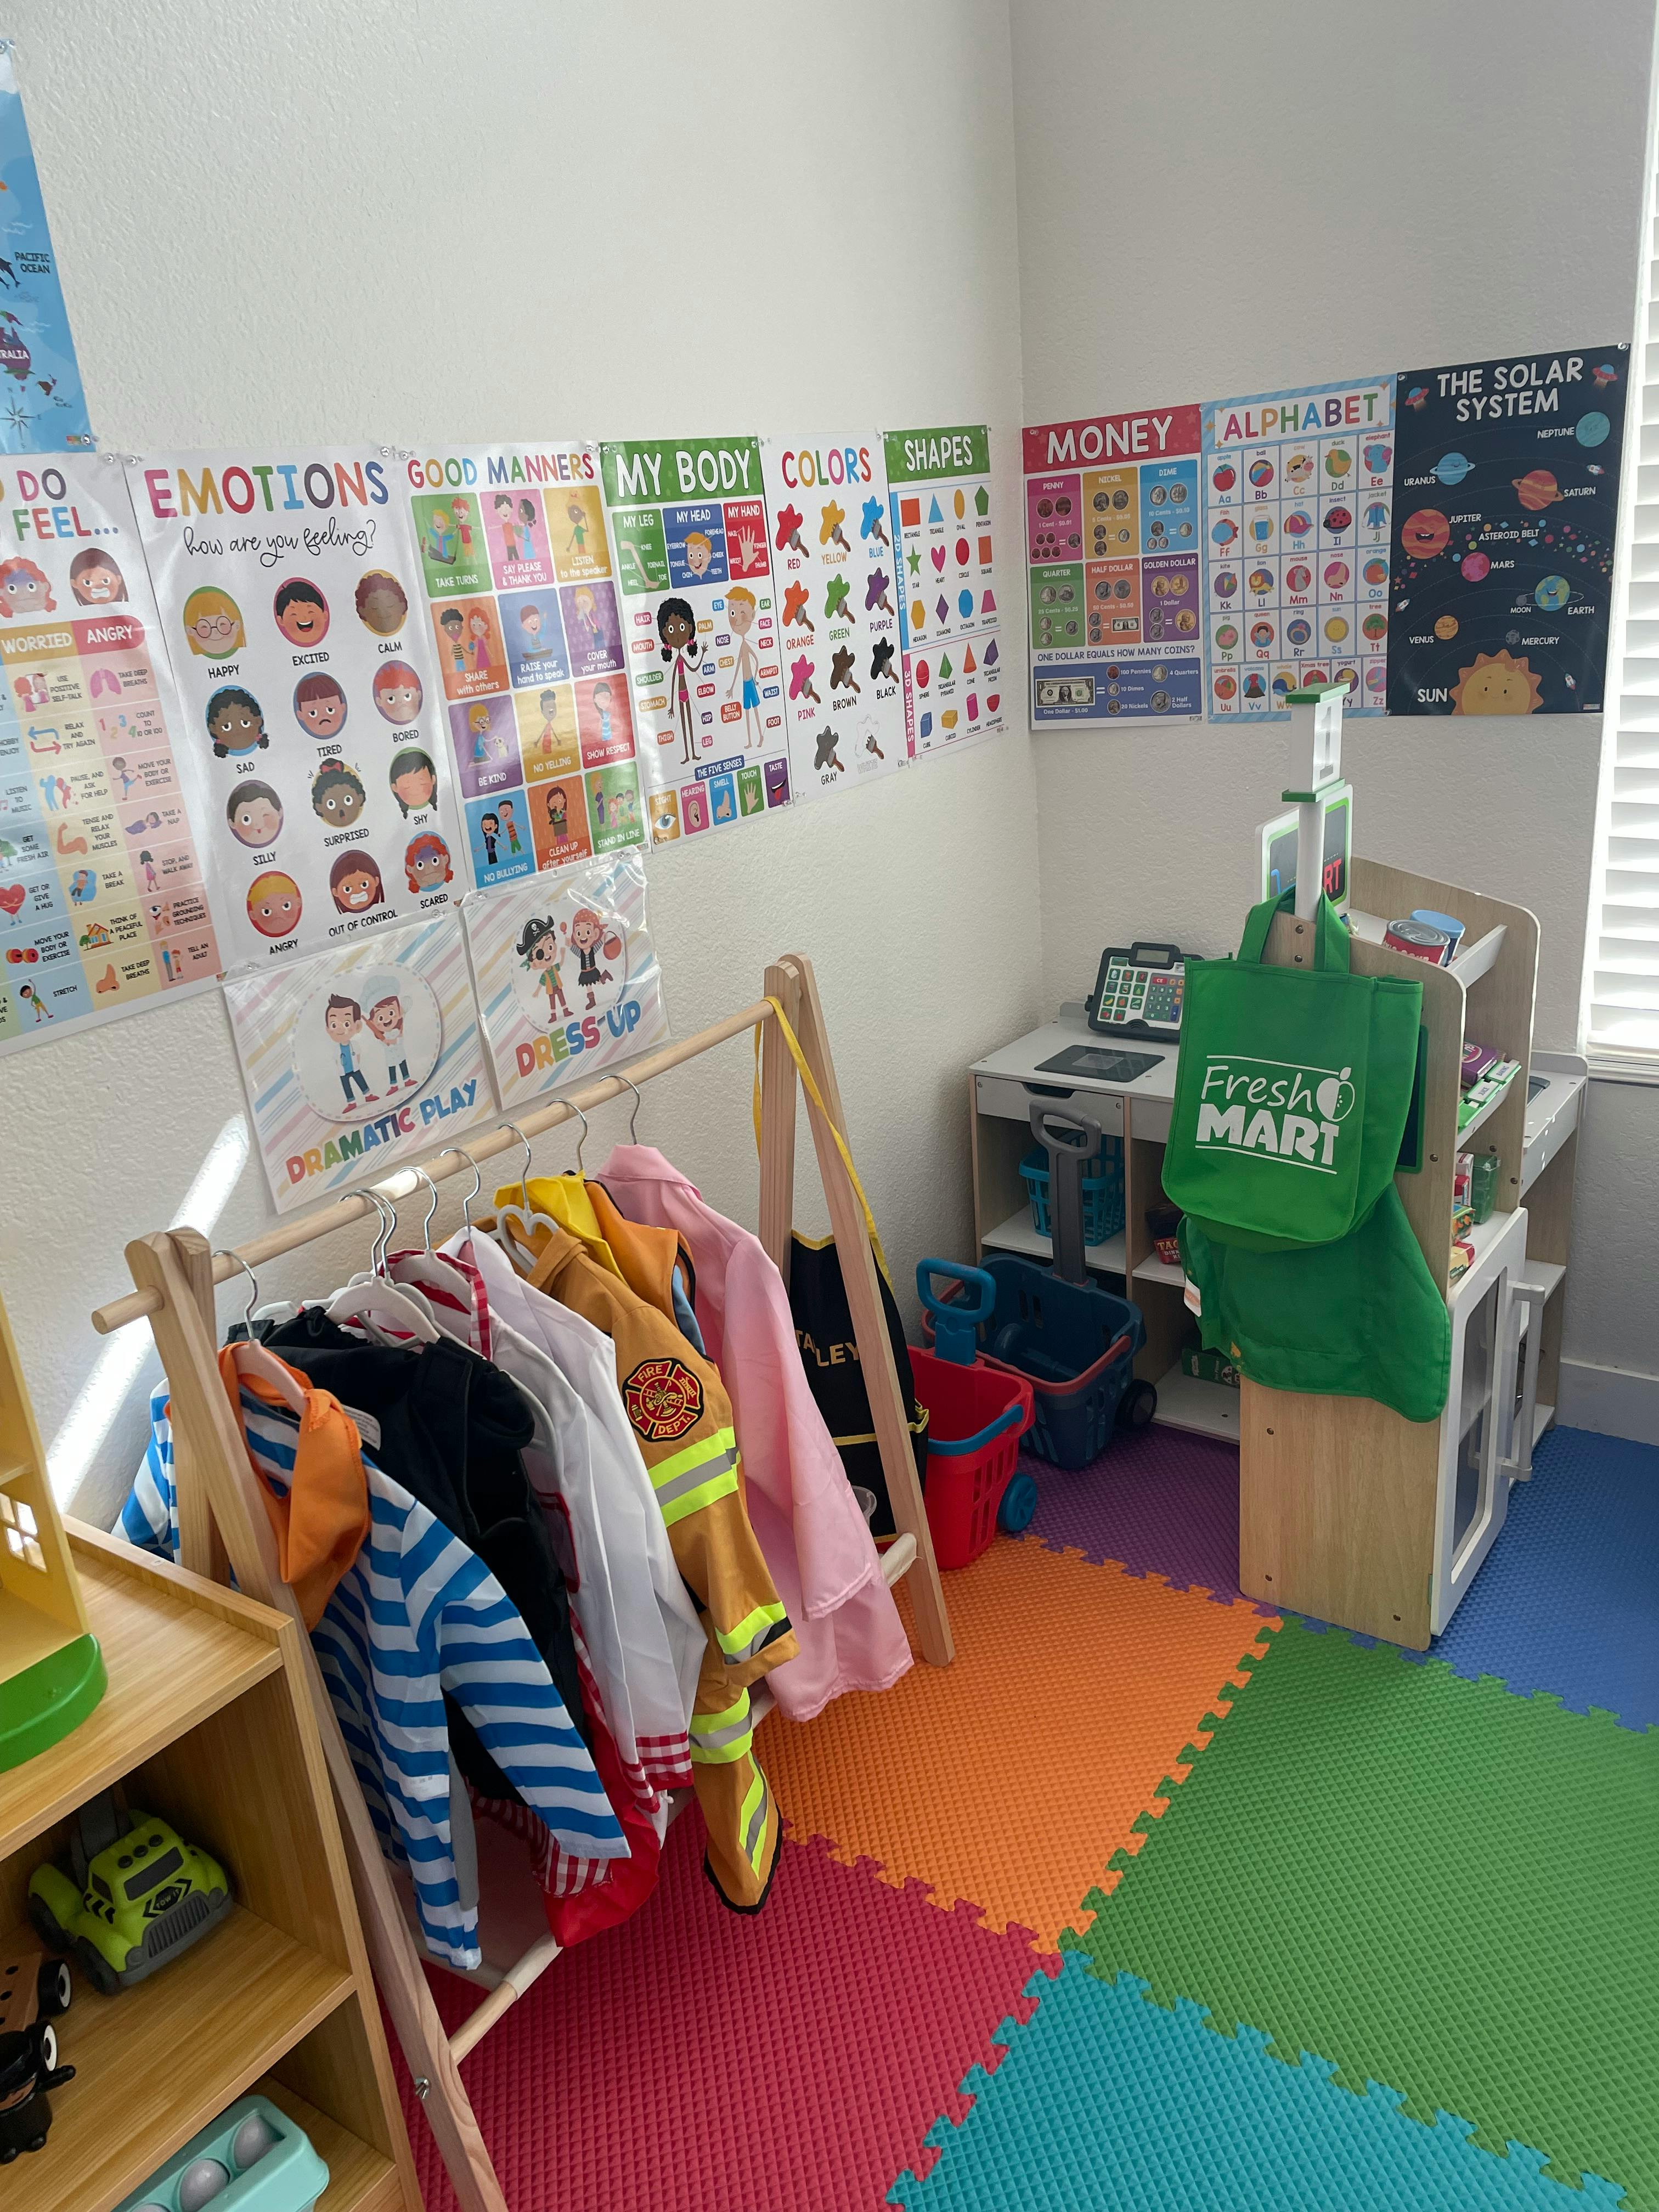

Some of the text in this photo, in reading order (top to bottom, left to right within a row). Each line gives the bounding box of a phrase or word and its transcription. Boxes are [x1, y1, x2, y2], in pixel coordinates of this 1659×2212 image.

[15, 251, 50, 262] PACIFIC
[20, 264, 50, 273] OCEAN
[1437, 357, 1584, 397] THE SOLAR
[1456, 388, 1559, 422] SYSTEM
[1223, 393, 1378, 441] ALPHABET
[1537, 427, 1575, 438] NEPTUNE
[1047, 415, 1173, 464] MONEY
[905, 435, 972, 471] SHAPES
[408, 453, 594, 488] GOOD MANNERS
[616, 448, 750, 498] MY BODY
[782, 447, 871, 488] COLORS
[1159, 468, 1177, 476] DIME
[16, 469, 66, 501] DO
[1098, 475, 1122, 483] NICKEL
[1331, 481, 1344, 490] Dd
[1404, 476, 1435, 486] URANUS
[144, 461, 388, 518] EMOTIONS
[1255, 491, 1267, 500] Bb
[1564, 487, 1596, 497] SATURN
[676, 509, 711, 523] MY HEAD
[728, 505, 760, 518] MY HAND
[623, 515, 654, 528] MY LEG
[1449, 514, 1481, 523] JUPITER
[1479, 529, 1539, 541] ASTEROID BELT
[184, 517, 376, 567] how are you feeling?
[821, 552, 847, 565] YELLOW
[869, 547, 884, 557] BLUE
[504, 562, 542, 574] SAY PLEASE
[788, 559, 800, 570] RED
[1491, 561, 1515, 569] MARS
[503, 572, 547, 585] & THANK YOU
[894, 534, 906, 610] 2D SHAPES
[1043, 569, 1070, 578] QUARTER
[435, 574, 478, 588] TAKE TURNS
[1290, 596, 1308, 605] Mm
[1330, 592, 1343, 601] Nn
[1568, 606, 1594, 615] EARTH
[636, 613, 651, 623] HAIR
[698, 622, 713, 630] PALM
[870, 619, 893, 632] PURPLE
[87, 625, 133, 644] ANGRY
[716, 636, 729, 644] NOSE
[829, 628, 850, 641] GREEN
[1409, 636, 1434, 644] VENUS
[1, 633, 72, 654] WORRIED
[377, 642, 402, 653] CALM
[633, 642, 652, 651] MOUTH
[760, 639, 772, 647] NECK
[786, 635, 814, 650] ORANGE
[1521, 637, 1559, 646] MERCURY
[292, 652, 329, 666] EXCITED
[1037, 653, 1053, 661] ONE
[1055, 651, 1085, 660] DOLLAR
[1087, 650, 1115, 658] EQUALS
[1165, 645, 1195, 654] COINS?
[208, 665, 239, 678] HAPPY
[520, 661, 557, 673] RAISE your
[704, 665, 714, 674] ARM
[465, 670, 488, 681] SHARE
[517, 674, 534, 685] hand
[545, 669, 565, 680] speak
[636, 673, 662, 684] SHOULDER
[456, 682, 499, 695] with others
[698, 685, 714, 695] ELBOW
[876, 686, 896, 699] BLACK
[1417, 689, 1448, 703] SUN
[724, 703, 737, 712] BELLY
[833, 696, 857, 711] BROWN
[905, 671, 914, 742] 3D SHAPES
[723, 710, 740, 720] BUTTON
[798, 708, 815, 720] PINK
[768, 717, 780, 726] FOOT
[393, 730, 419, 742] BORED
[317, 745, 342, 757] TIRED
[587, 743, 630, 760] SHOW RESPECT
[236, 762, 255, 774] SAD
[697, 758, 742, 777] THE FIVE SENSES
[769, 762, 783, 771] TASTE
[478, 772, 507, 786] BE KIND
[742, 770, 757, 779] TOUCH
[821, 772, 837, 785] GRAY
[714, 778, 729, 788] SMELL
[682, 785, 705, 798] HEARING
[414, 814, 428, 825] SHY
[324, 829, 369, 847] SURPRISED
[549, 842, 579, 857] CLEAN UP
[253, 851, 276, 866] SILLY
[102, 872, 116, 881] TAKE
[484, 862, 528, 883] NO BULLYING
[105, 879, 124, 889] BREAK
[420, 894, 448, 909] SCARED
[329, 910, 398, 937] OUT OF CONTROL
[35, 932, 69, 946] MOVE YOUR
[41, 945, 57, 953] BODY
[269, 940, 298, 955] ANGRY
[42, 950, 71, 962] EXERCISE
[53, 986, 77, 997] STRETCH
[516, 1000, 641, 1079] DRESS UP
[1201, 1065, 1312, 1113] Fresh
[286, 1079, 478, 1185] DRAMATIC PLAY
[1195, 1103, 1339, 1166] MART
[637, 1365, 663, 1383] FIRE
[658, 1415, 691, 1434] DEPT.
